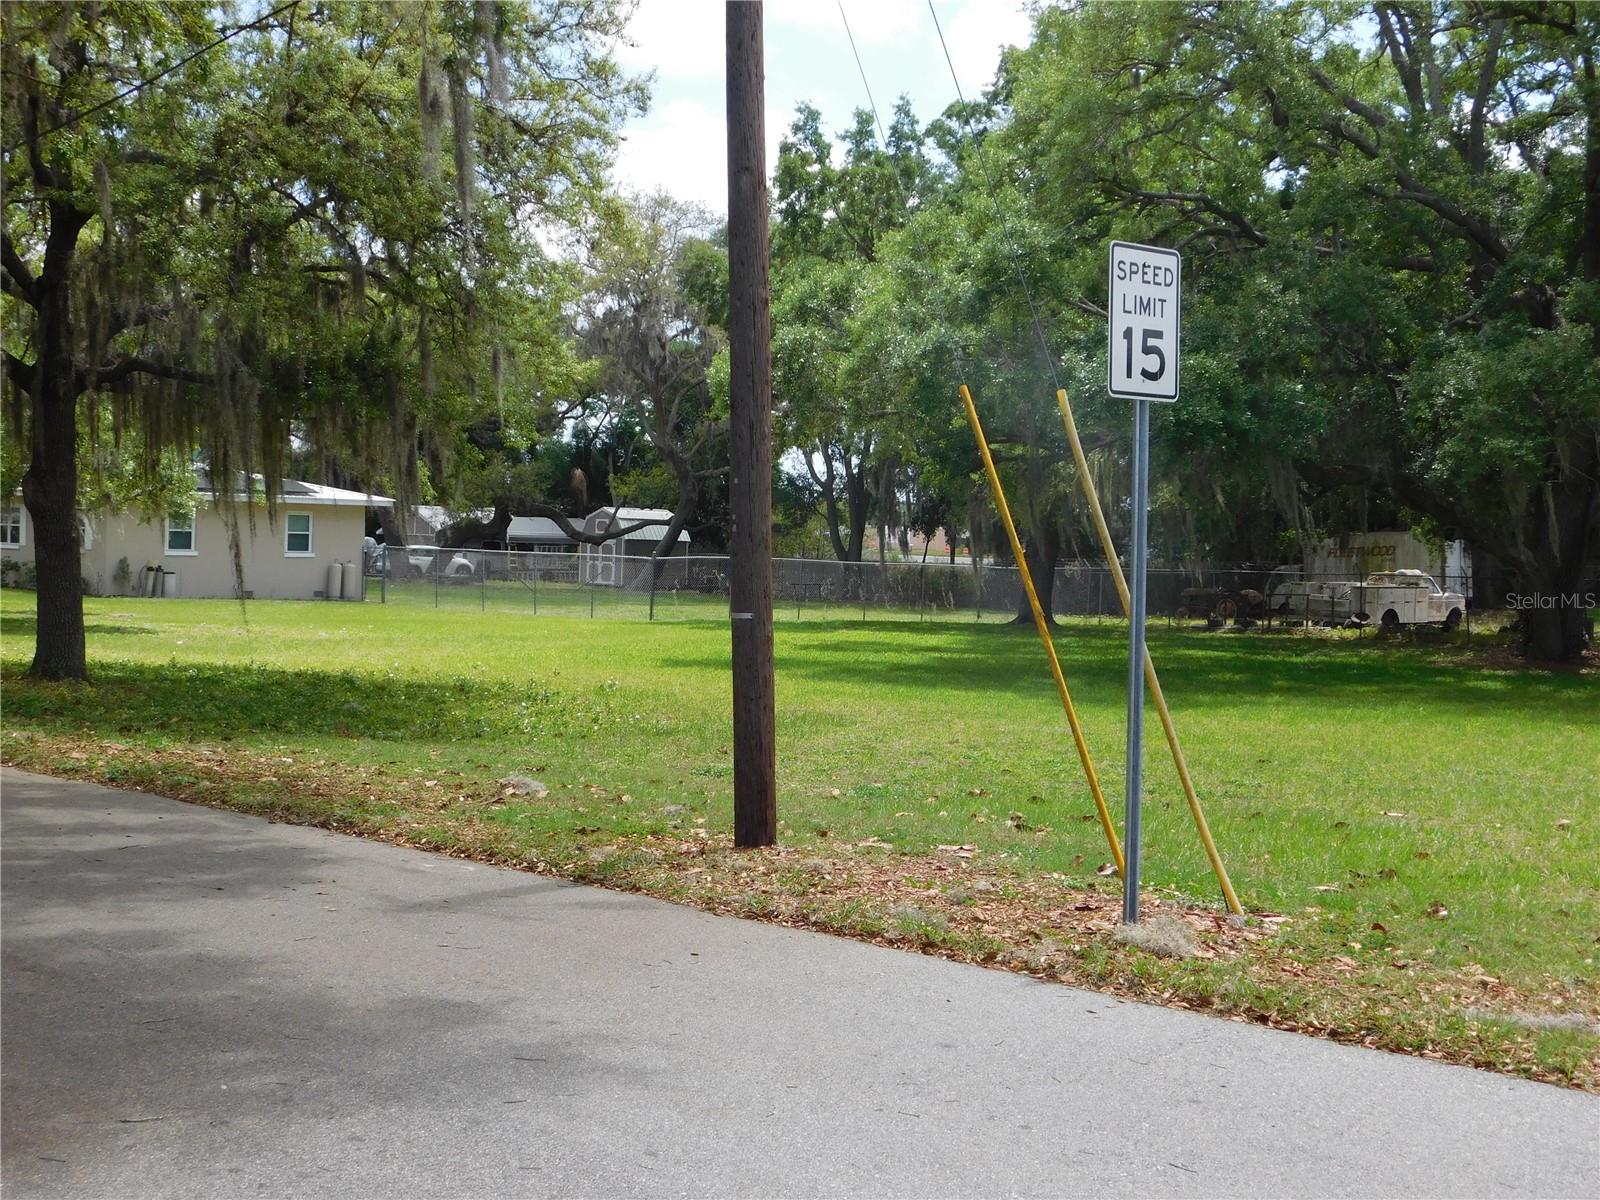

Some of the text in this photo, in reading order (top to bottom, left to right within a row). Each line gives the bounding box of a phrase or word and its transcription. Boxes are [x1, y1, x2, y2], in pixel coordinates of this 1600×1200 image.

[1117, 260, 1174, 287] SPEED
[1123, 293, 1167, 318] LIMIT
[1123, 326, 1166, 382] 15
